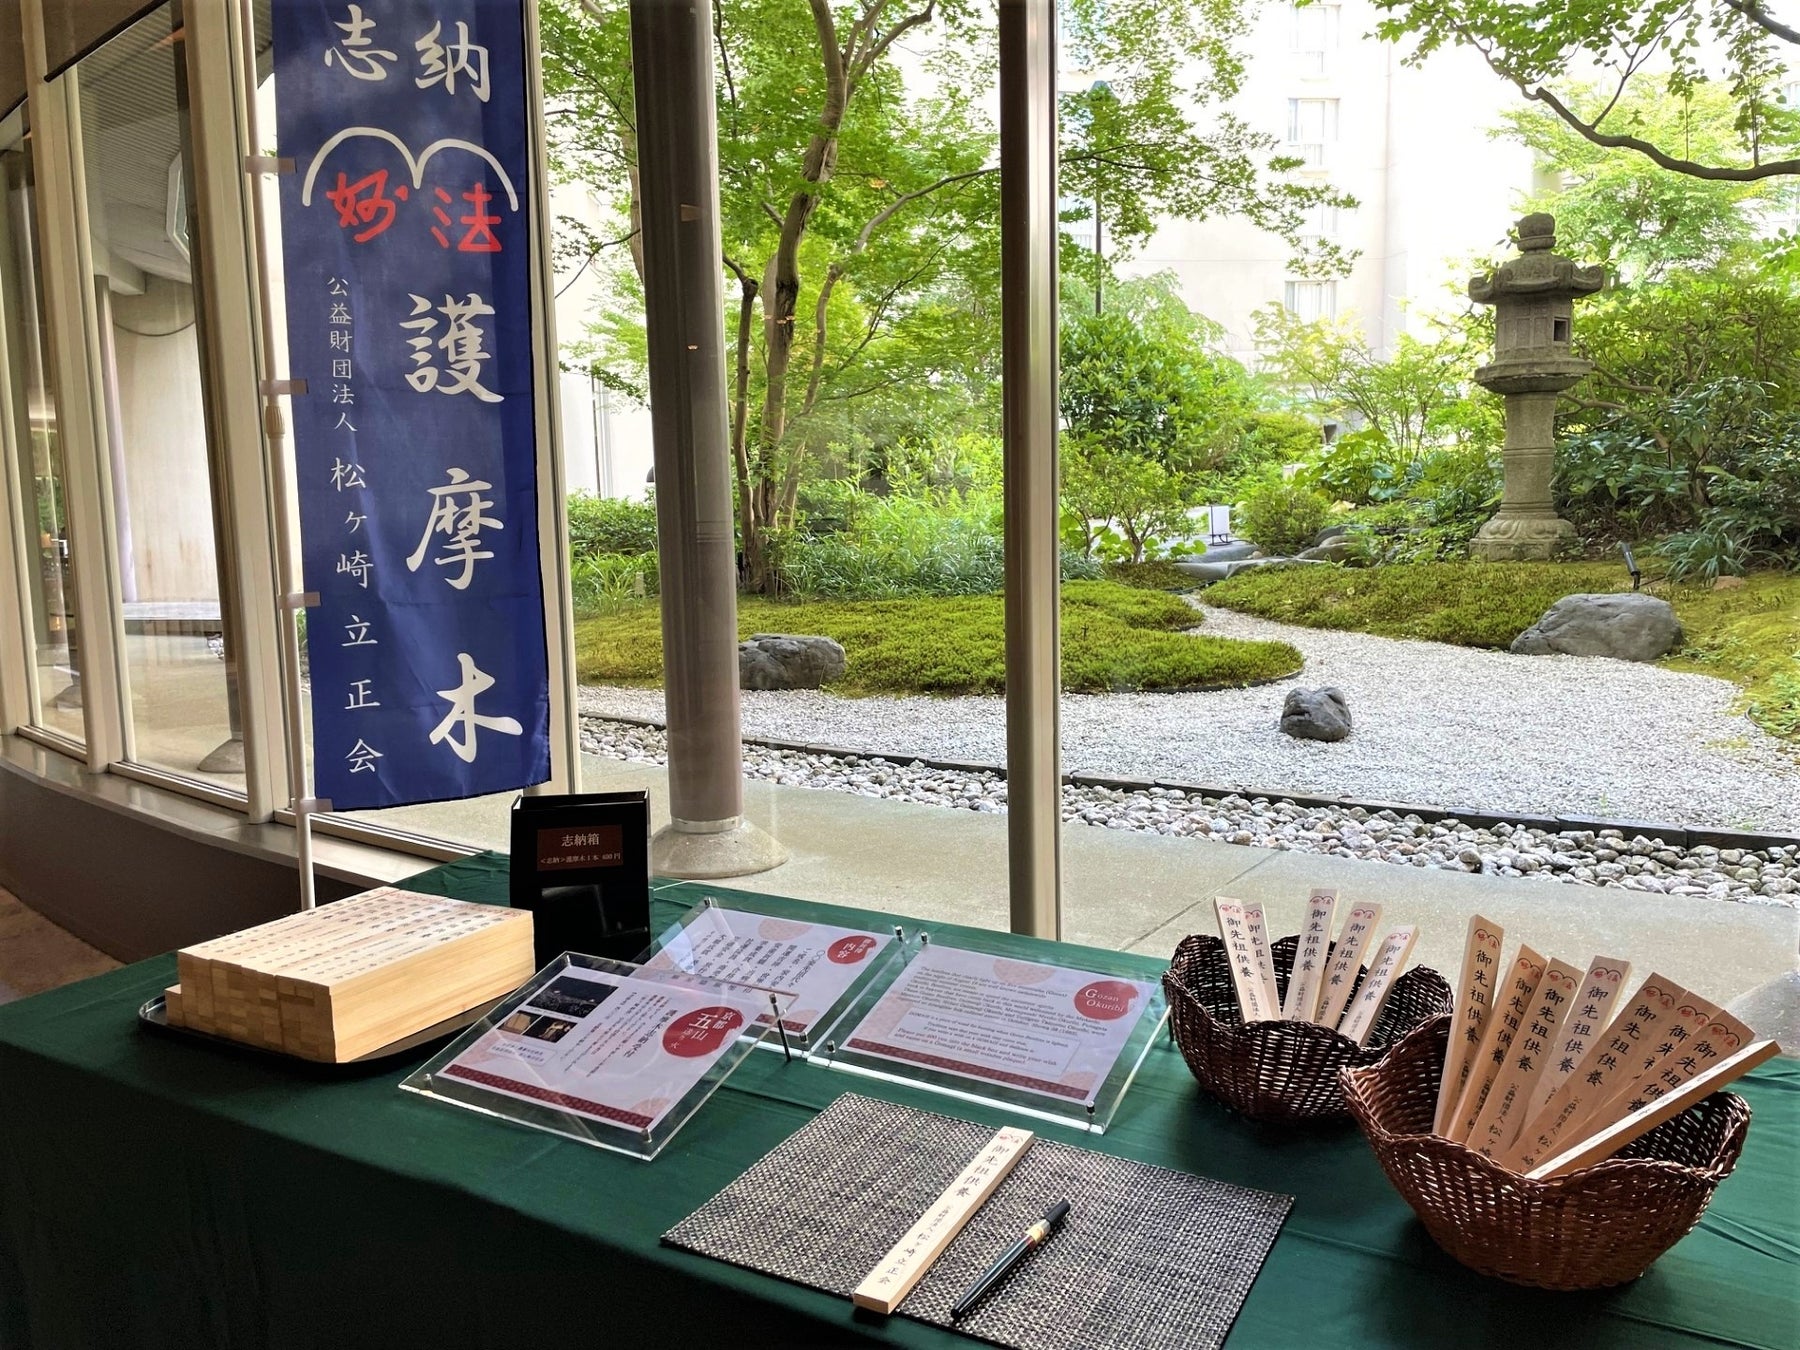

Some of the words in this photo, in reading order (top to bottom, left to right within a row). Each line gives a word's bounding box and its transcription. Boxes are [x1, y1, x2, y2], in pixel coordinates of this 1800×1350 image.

[325, 4, 491, 103] 志納
[327, 277, 357, 433] 公益財団法人
[399, 293, 523, 763] 護摩木
[561, 833, 600, 847] 志納箱
[1226, 917, 1254, 978] 御先祖供養
[1302, 909, 1327, 972] 御先祖供養
[1330, 923, 1366, 986] 御先祖供養
[1365, 944, 1401, 1001] 御先祖供養
[712, 1012, 736, 1029] 京都
[1085, 989, 1119, 1001] Gozan
[1086, 999, 1123, 1012] Okuribi
[1464, 949, 1492, 1044] 御先祖供養
[1491, 977, 1532, 1065] 御先祖供養
[1518, 988, 1564, 1072] 御先祖供養
[1558, 986, 1608, 1074] 御先祖供養
[1585, 1004, 1656, 1087] 御先祖供養
